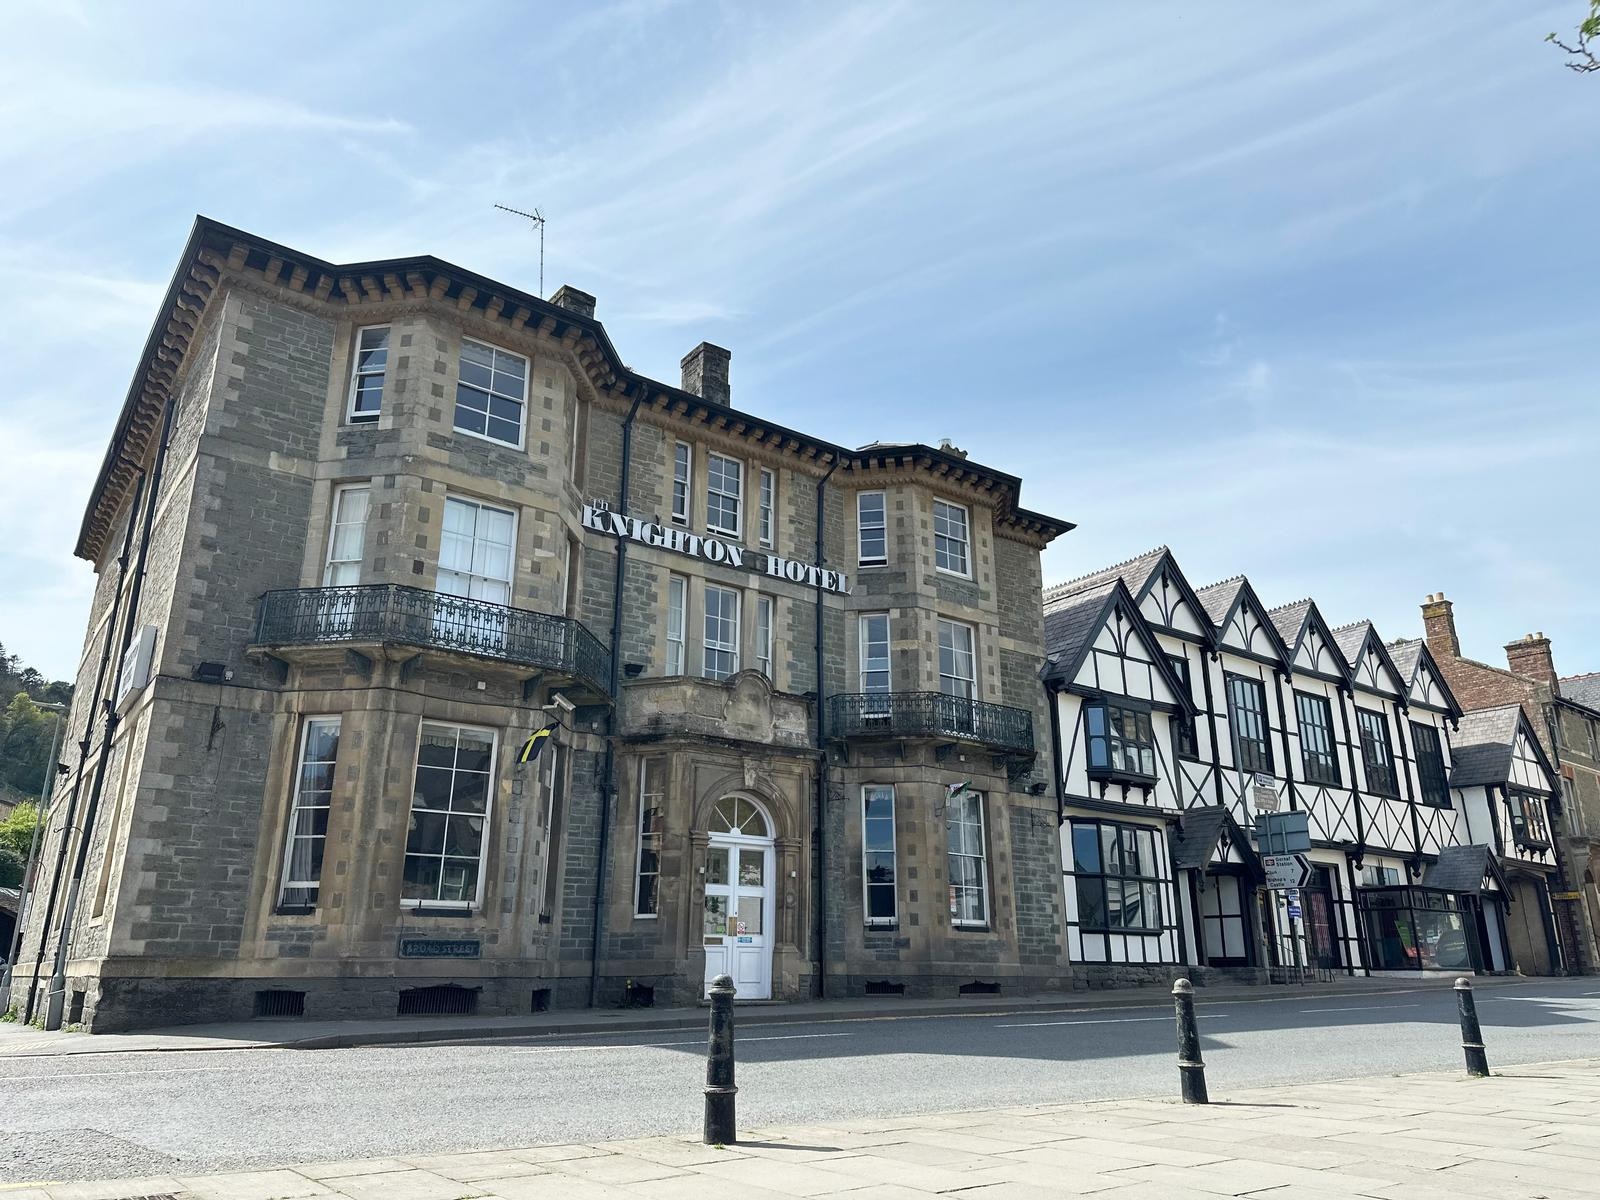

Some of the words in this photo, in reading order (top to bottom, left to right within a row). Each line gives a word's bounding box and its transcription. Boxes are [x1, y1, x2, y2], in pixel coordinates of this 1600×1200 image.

[582, 504, 746, 567] KNIGHTON
[766, 554, 852, 595] HOTEL
[441, 944, 477, 954] STREET
